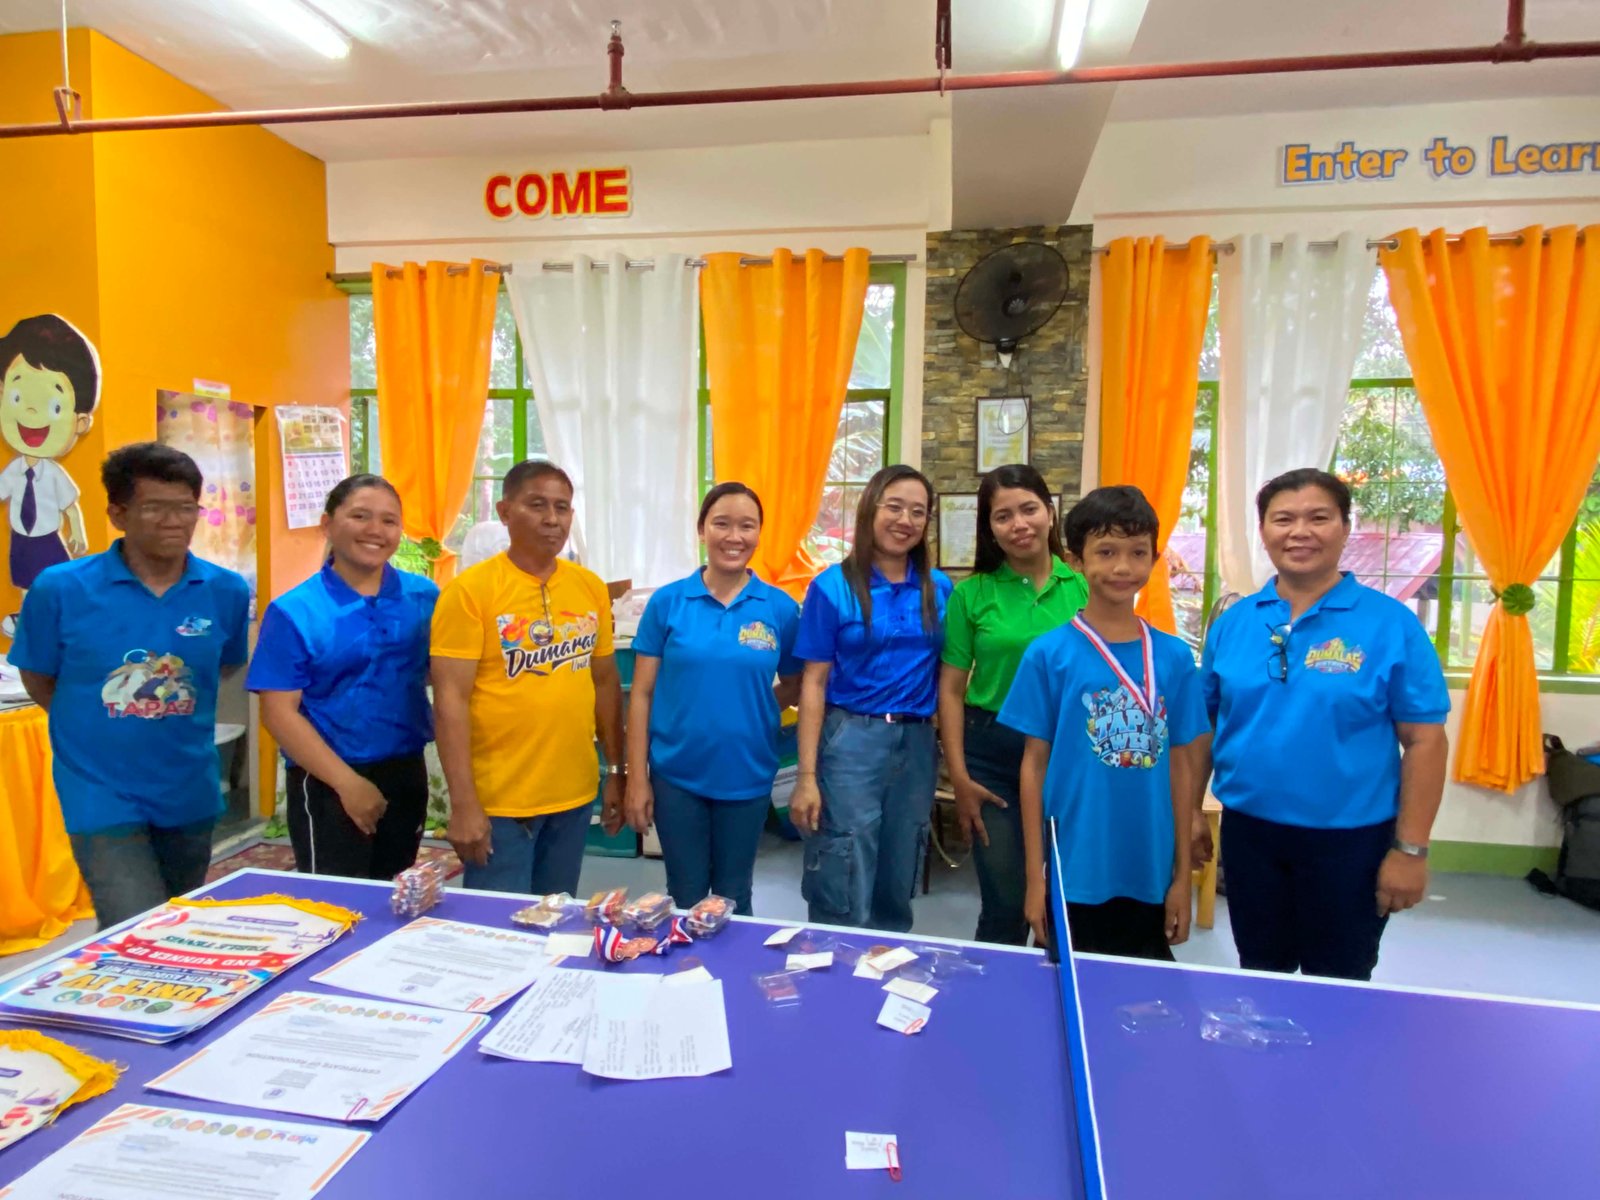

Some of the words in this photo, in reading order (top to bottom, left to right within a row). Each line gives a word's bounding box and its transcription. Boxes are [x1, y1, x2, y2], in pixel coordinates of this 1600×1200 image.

[1284, 141, 1408, 183] Enter
[1425, 137, 1476, 176] to
[486, 169, 628, 217] COME
[1109, 732, 1155, 751] WES
[126, 944, 151, 957] UP
[153, 951, 217, 967] RUNNER
[60, 975, 118, 992] IV
[109, 979, 210, 1003] UNIT
